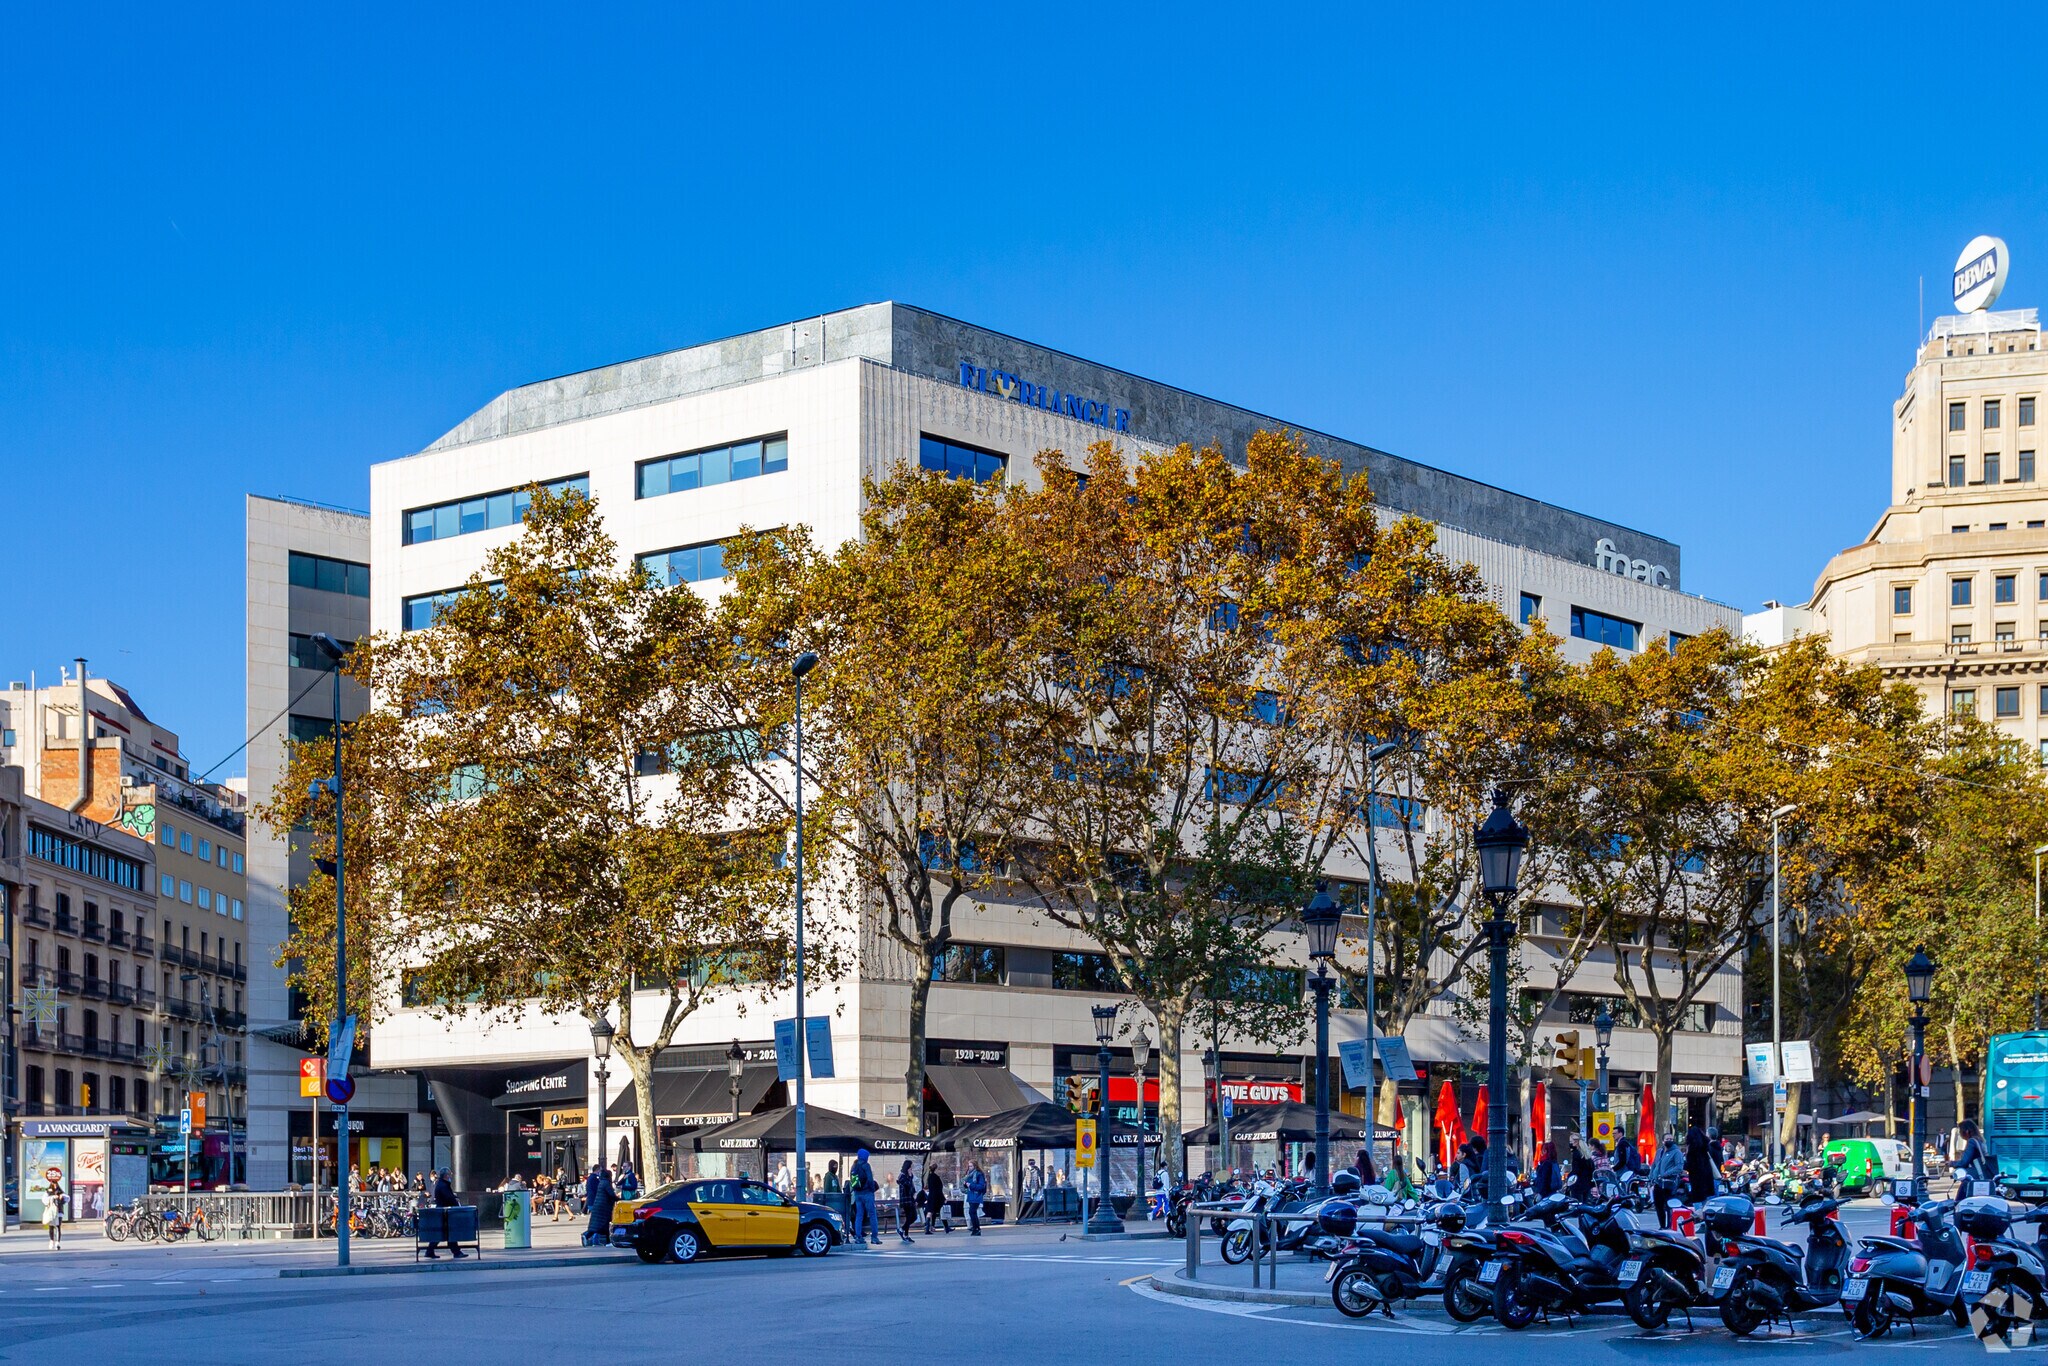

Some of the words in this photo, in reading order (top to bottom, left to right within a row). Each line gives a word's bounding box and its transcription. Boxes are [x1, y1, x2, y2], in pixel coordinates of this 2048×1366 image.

[1954, 255, 1995, 298] BBVA
[991, 369, 1130, 433] TRIANGLE
[1595, 538, 1670, 590] fnac
[955, 1049, 974, 1060] 1920
[981, 1051, 999, 1060] 2020
[506, 1080, 540, 1093] SHOPPING
[541, 1076, 567, 1090] CENTRE
[1221, 1084, 1248, 1100] FIVE
[1250, 1085, 1289, 1101] GUYS
[1118, 1107, 1147, 1119] FIV
[560, 1114, 584, 1125] Amorino
[619, 1119, 638, 1127] CAFE
[684, 1117, 703, 1125] CAFE
[51, 1124, 112, 1133] VANGUARD
[1113, 1134, 1131, 1143] CAFE
[1132, 1134, 1162, 1143] ZRICH
[1252, 1131, 1277, 1140] ZURICH
[720, 1138, 734, 1148] CAFE
[735, 1138, 758, 1148] ZURICH
[874, 1141, 897, 1150] CAFE
[898, 1141, 931, 1150] ZURICH
[974, 1139, 990, 1147] CAFE
[307, 1146, 326, 1154] Thgs
[1850, 1281, 1866, 1289] 5679
